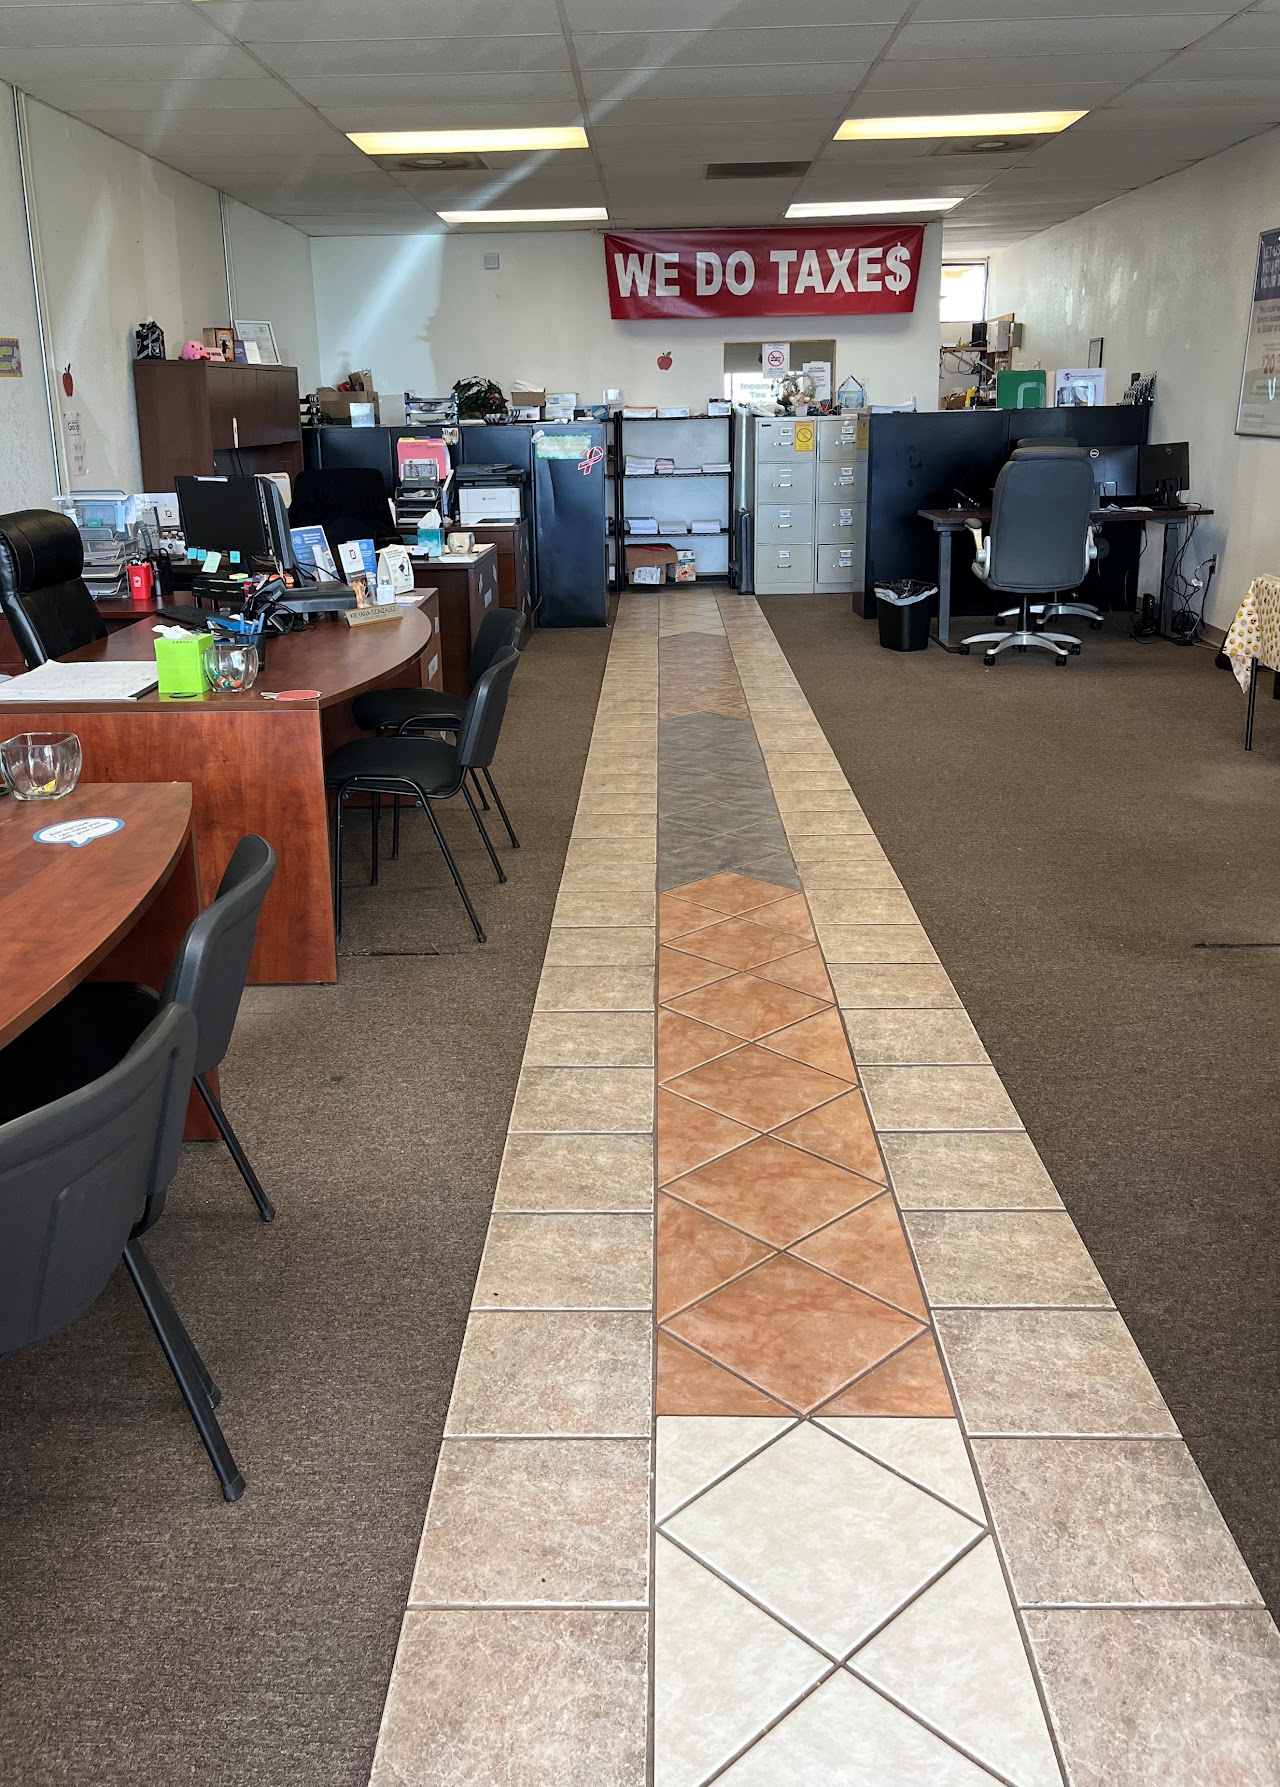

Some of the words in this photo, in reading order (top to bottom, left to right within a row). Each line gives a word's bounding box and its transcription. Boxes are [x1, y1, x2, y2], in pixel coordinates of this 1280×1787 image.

[614, 253, 680, 297] WE
[696, 250, 755, 296] DO
[770, 242, 912, 295] TAXE$
